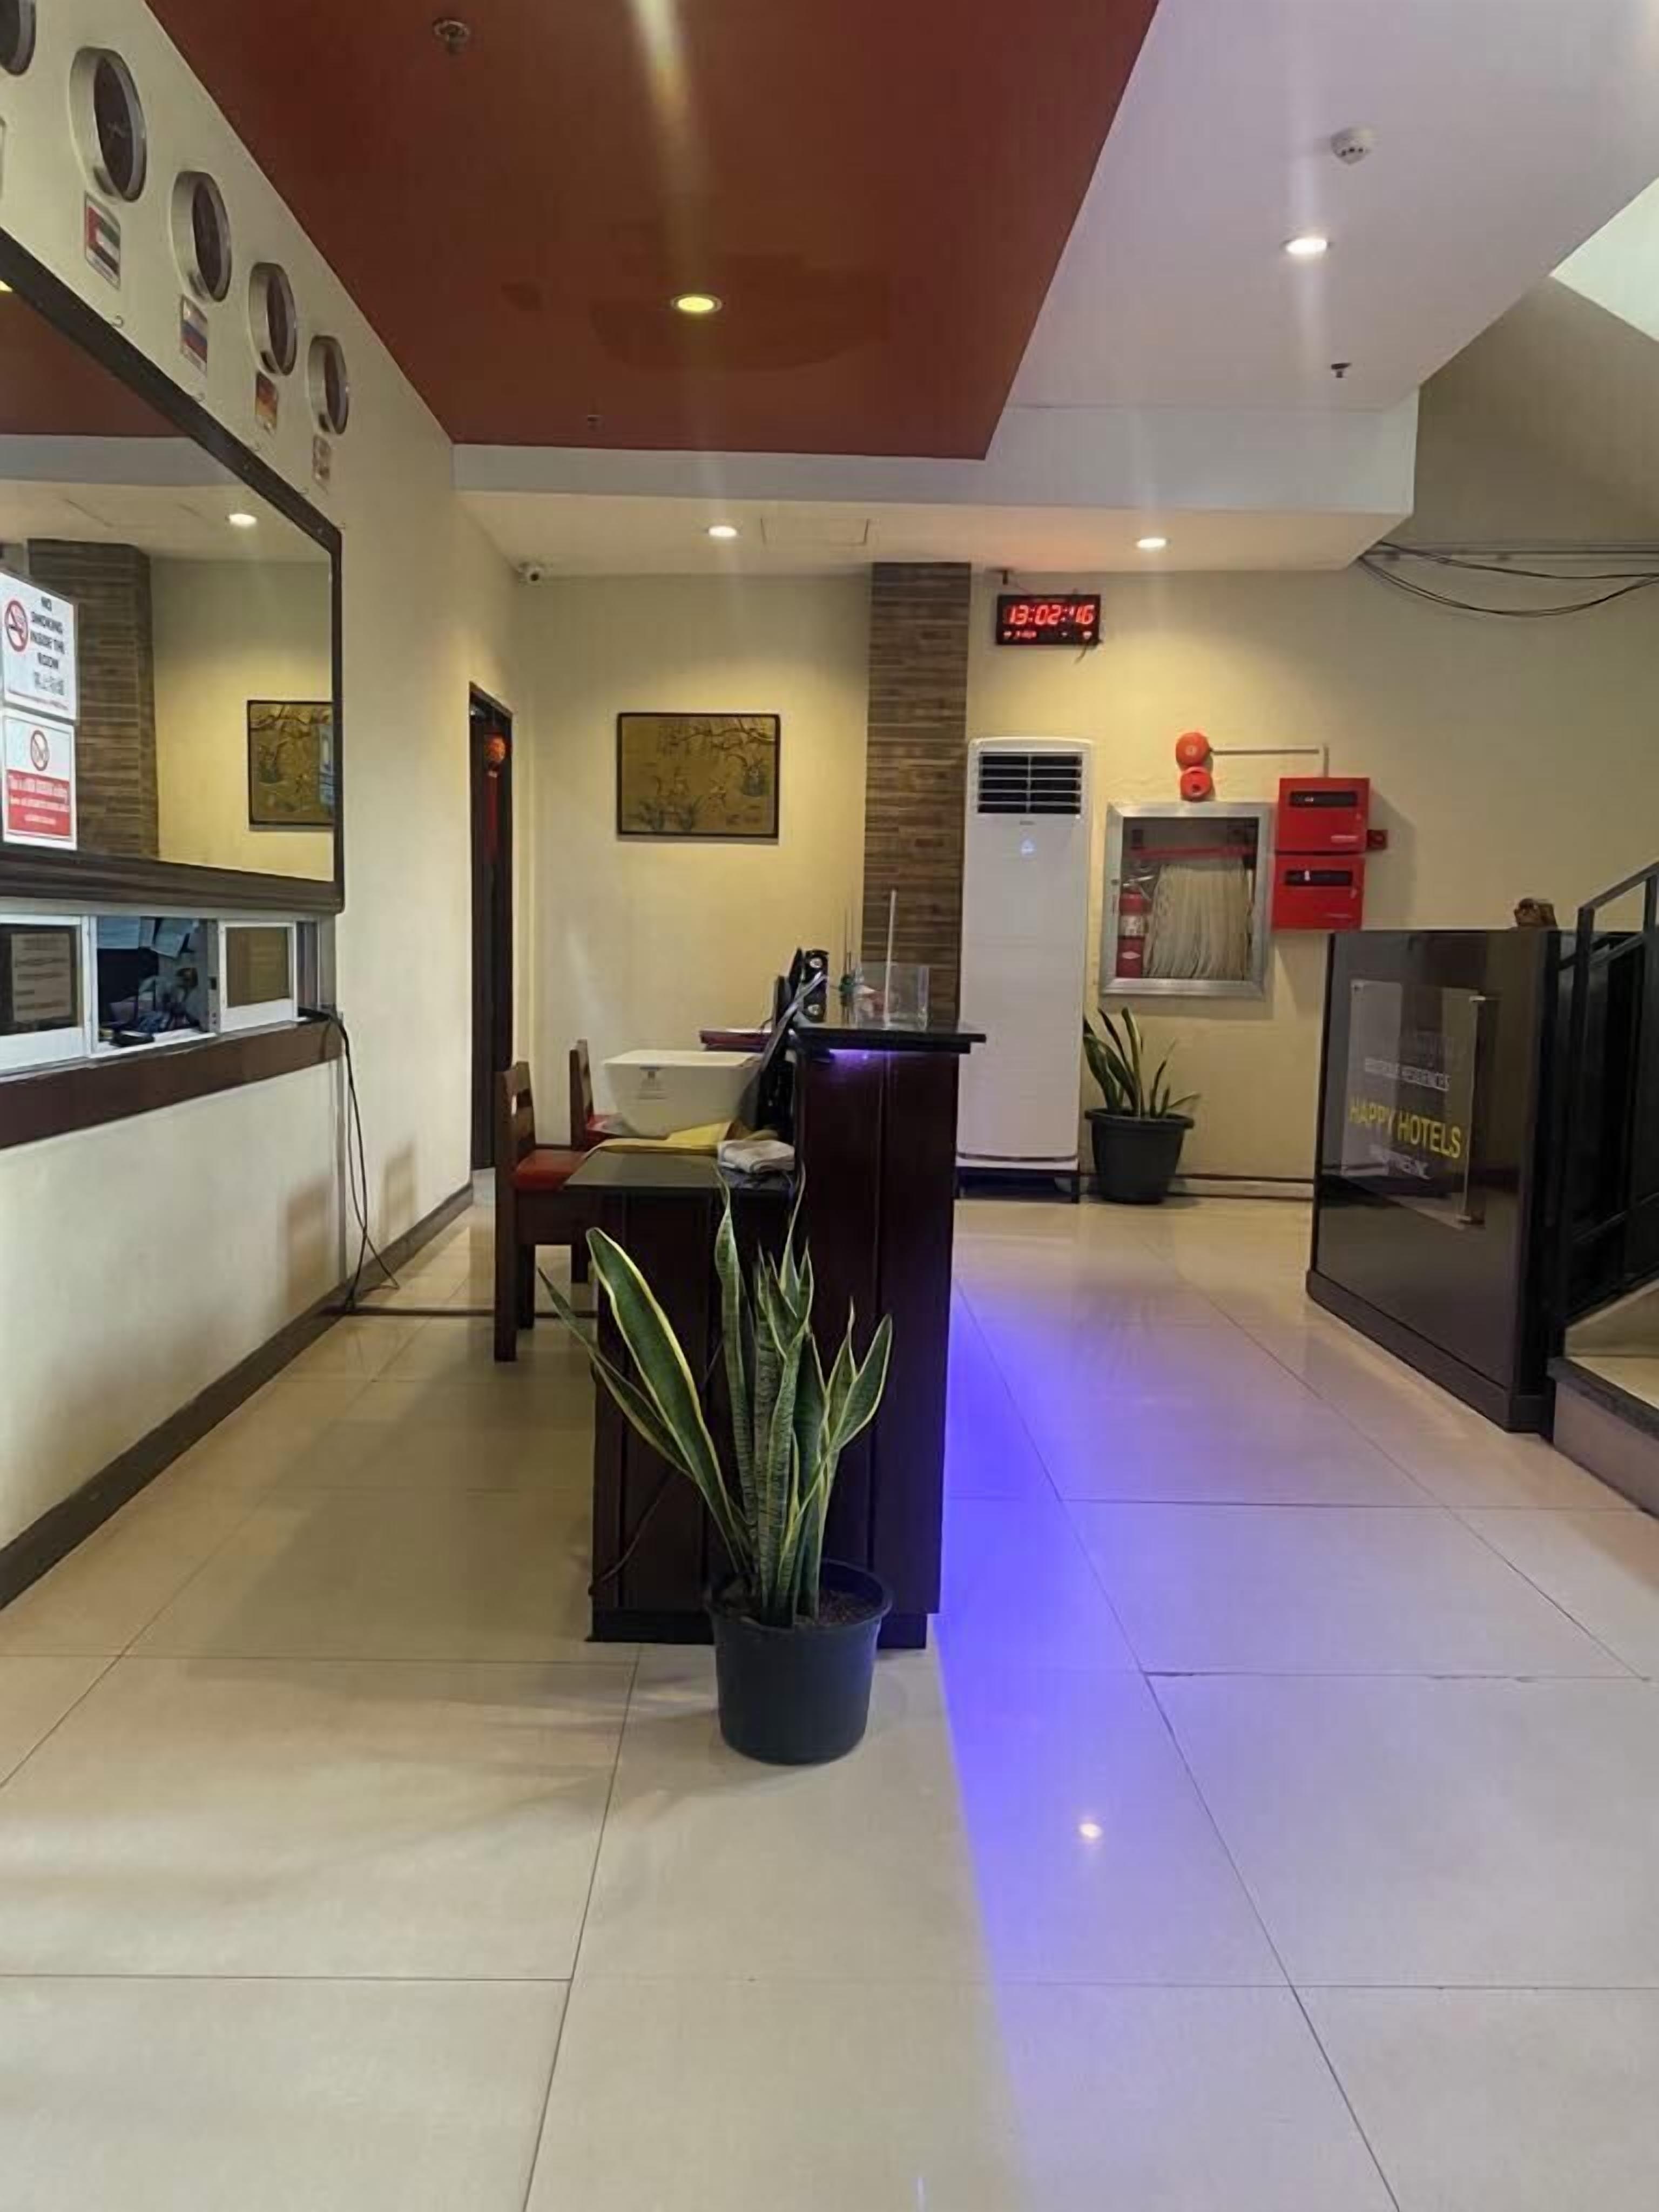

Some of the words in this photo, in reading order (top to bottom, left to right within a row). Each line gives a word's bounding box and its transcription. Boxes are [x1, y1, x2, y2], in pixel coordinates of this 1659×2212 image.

[31, 611, 63, 634] SMOKING
[1349, 1096, 1396, 1136] HAPPY
[1398, 1110, 1461, 1159] HOTELS
